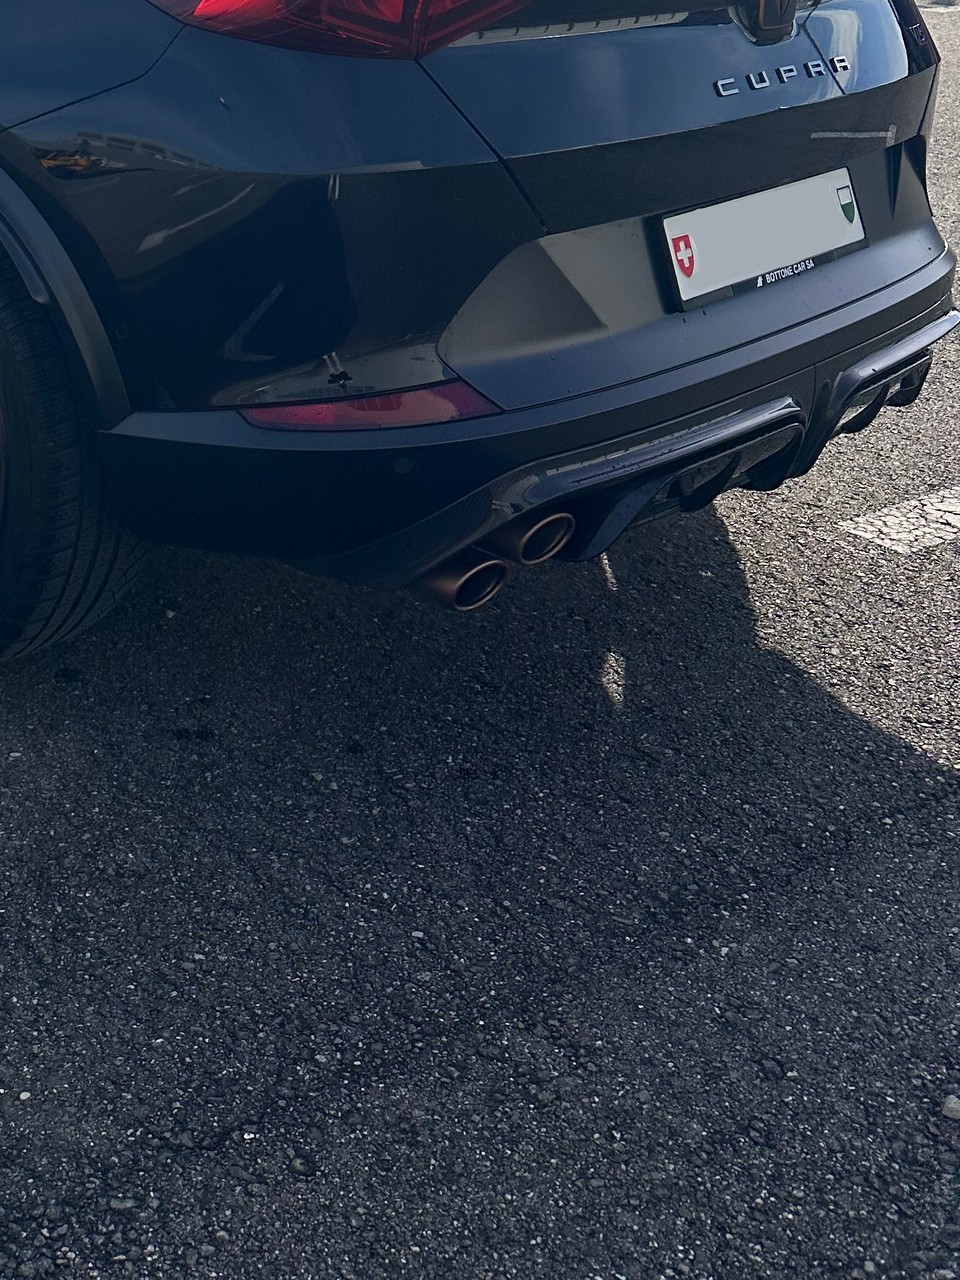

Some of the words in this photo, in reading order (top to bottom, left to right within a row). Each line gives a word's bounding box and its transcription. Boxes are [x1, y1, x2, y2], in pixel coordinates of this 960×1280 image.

[713, 55, 851, 97] CUPRA
[765, 266, 794, 284] BOTTONE
[794, 261, 807, 274] CAR
[806, 258, 815, 269] SA
